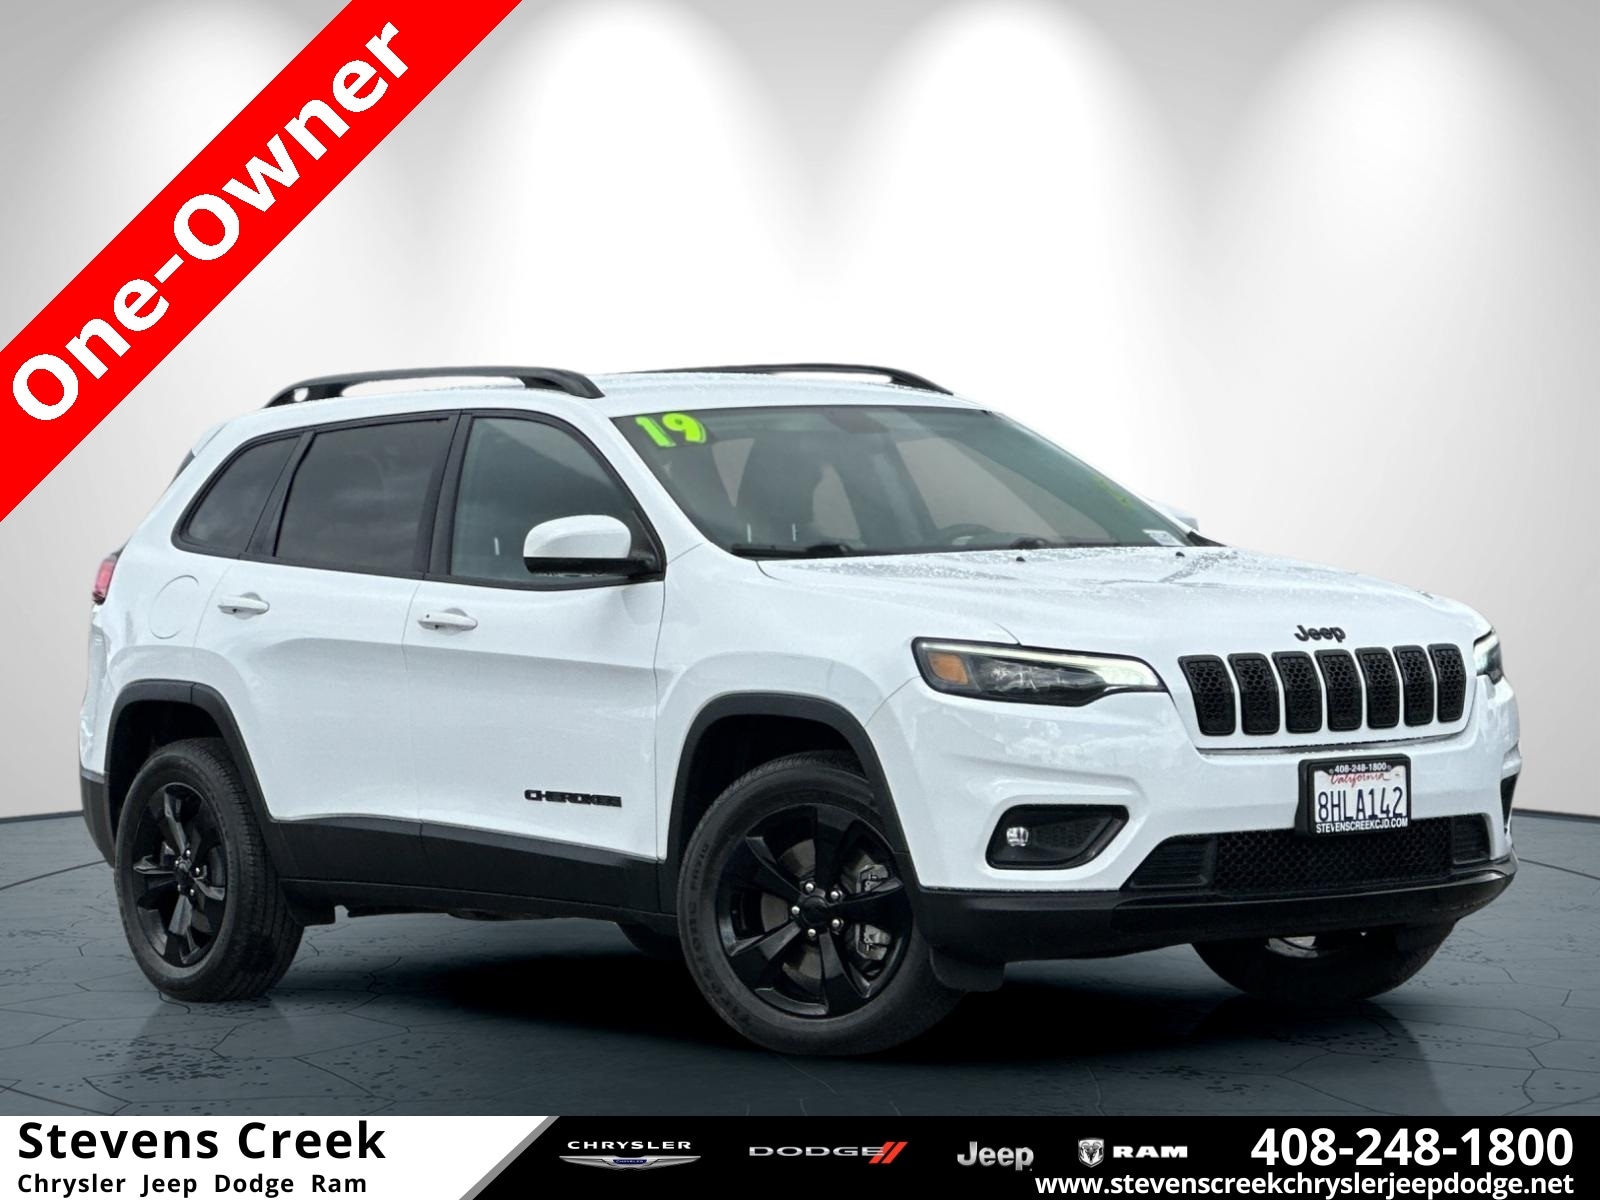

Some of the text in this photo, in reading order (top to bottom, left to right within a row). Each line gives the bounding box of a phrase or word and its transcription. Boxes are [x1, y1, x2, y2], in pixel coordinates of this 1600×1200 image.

[635, 413, 707, 447] 19
[1294, 625, 1346, 643] Jeep
[1334, 762, 1387, 773] 408-248-1800
[1330, 772, 1390, 788] California
[524, 789, 622, 808] CHEROKEE
[1318, 786, 1403, 822] 8HLA142
[1315, 817, 1409, 834] STEVENSCREEKCJD.COM
